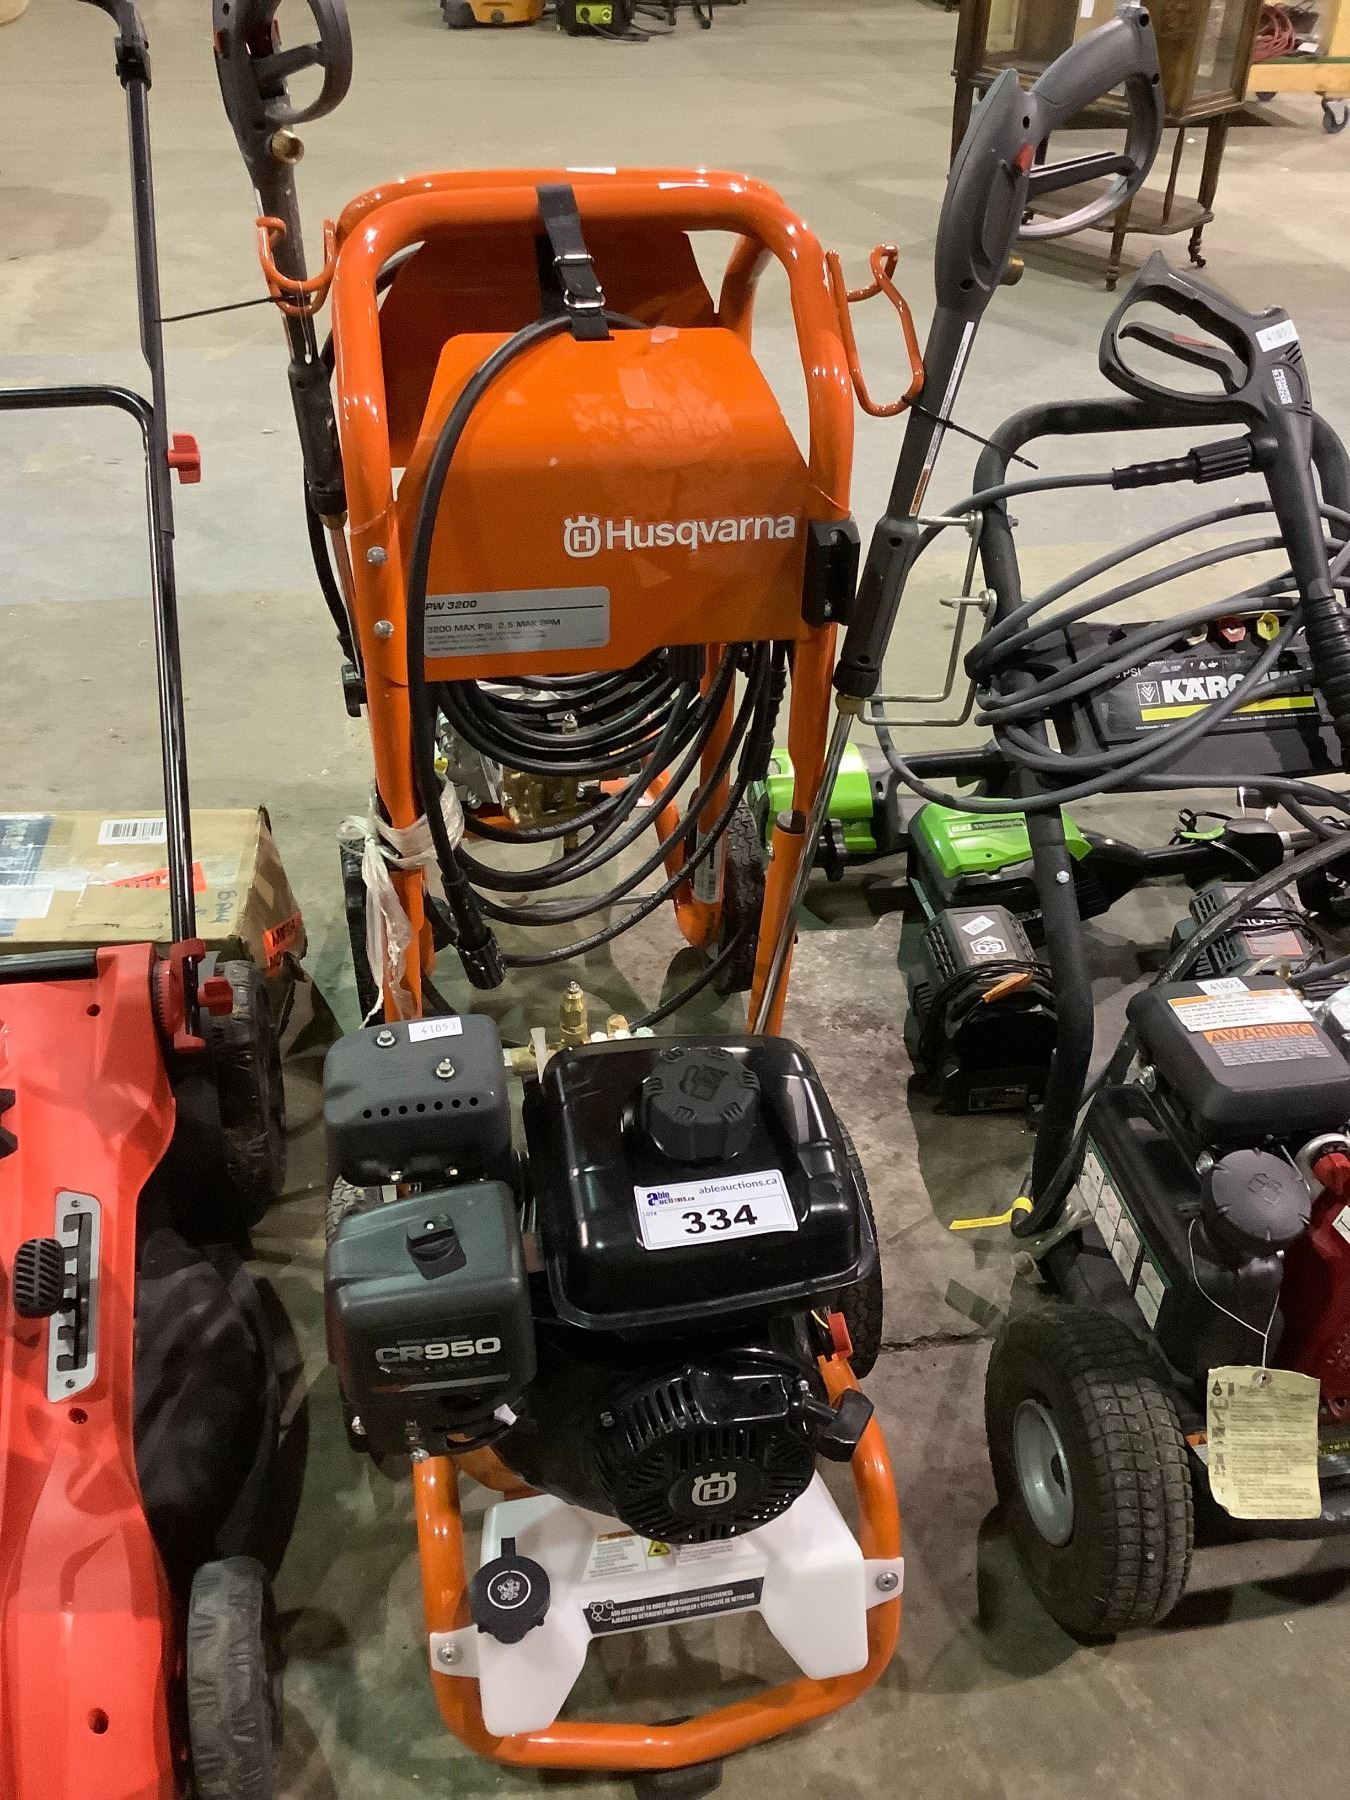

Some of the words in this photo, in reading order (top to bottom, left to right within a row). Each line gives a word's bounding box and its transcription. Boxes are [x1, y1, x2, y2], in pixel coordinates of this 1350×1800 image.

[606, 515, 797, 551] Husqvarna
[425, 602, 445, 612] PW
[447, 599, 477, 610] 3200
[427, 624, 452, 634] 3200
[454, 623, 476, 632] MAX
[1222, 1024, 1314, 1041] WARNING
[699, 1178, 778, 1195] ableauctions.ca
[681, 1204, 759, 1235] 334
[375, 1337, 502, 1363] CR950
